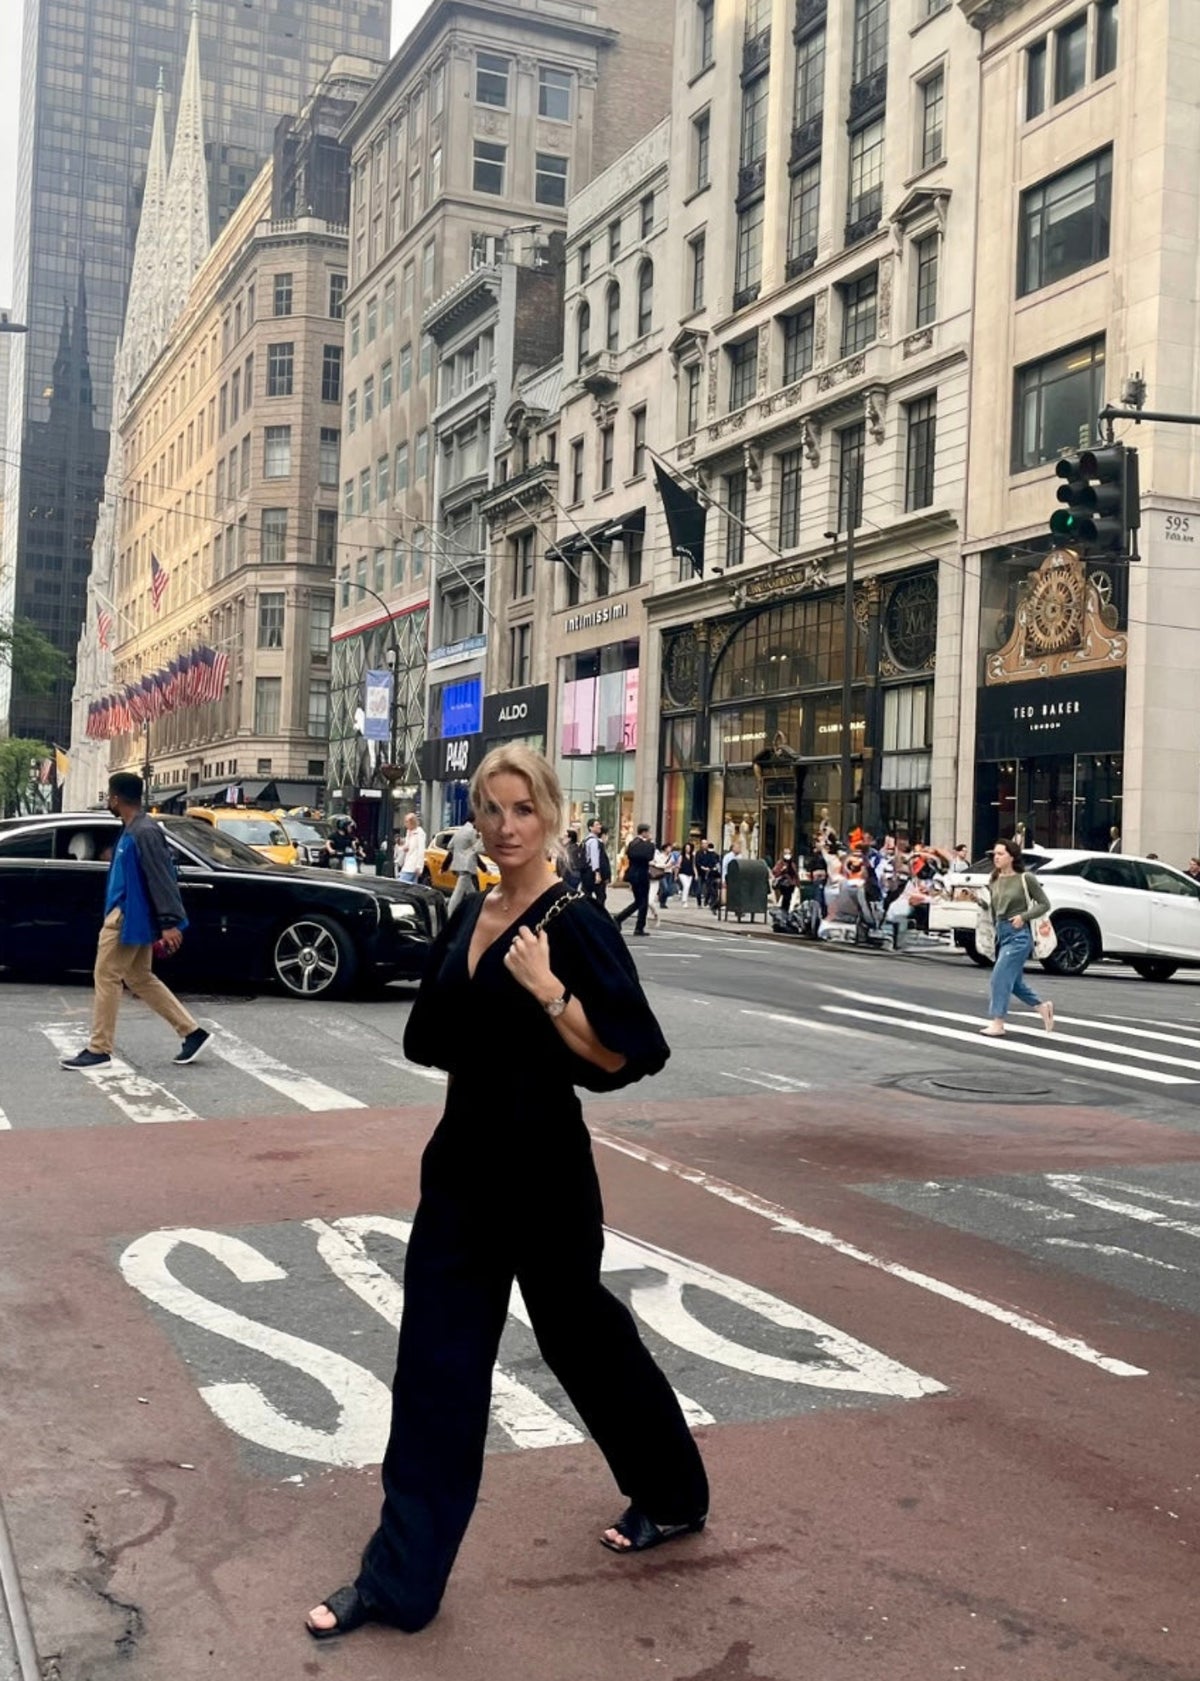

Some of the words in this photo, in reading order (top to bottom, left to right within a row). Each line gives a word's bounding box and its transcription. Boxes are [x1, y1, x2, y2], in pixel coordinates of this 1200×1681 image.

[1165, 515, 1189, 532] 595
[498, 703, 528, 722] ALDO
[1013, 706, 1034, 719] TED
[1042, 701, 1079, 717] BAKER
[818, 724, 839, 734] CLUB
[445, 740, 469, 773] P448
